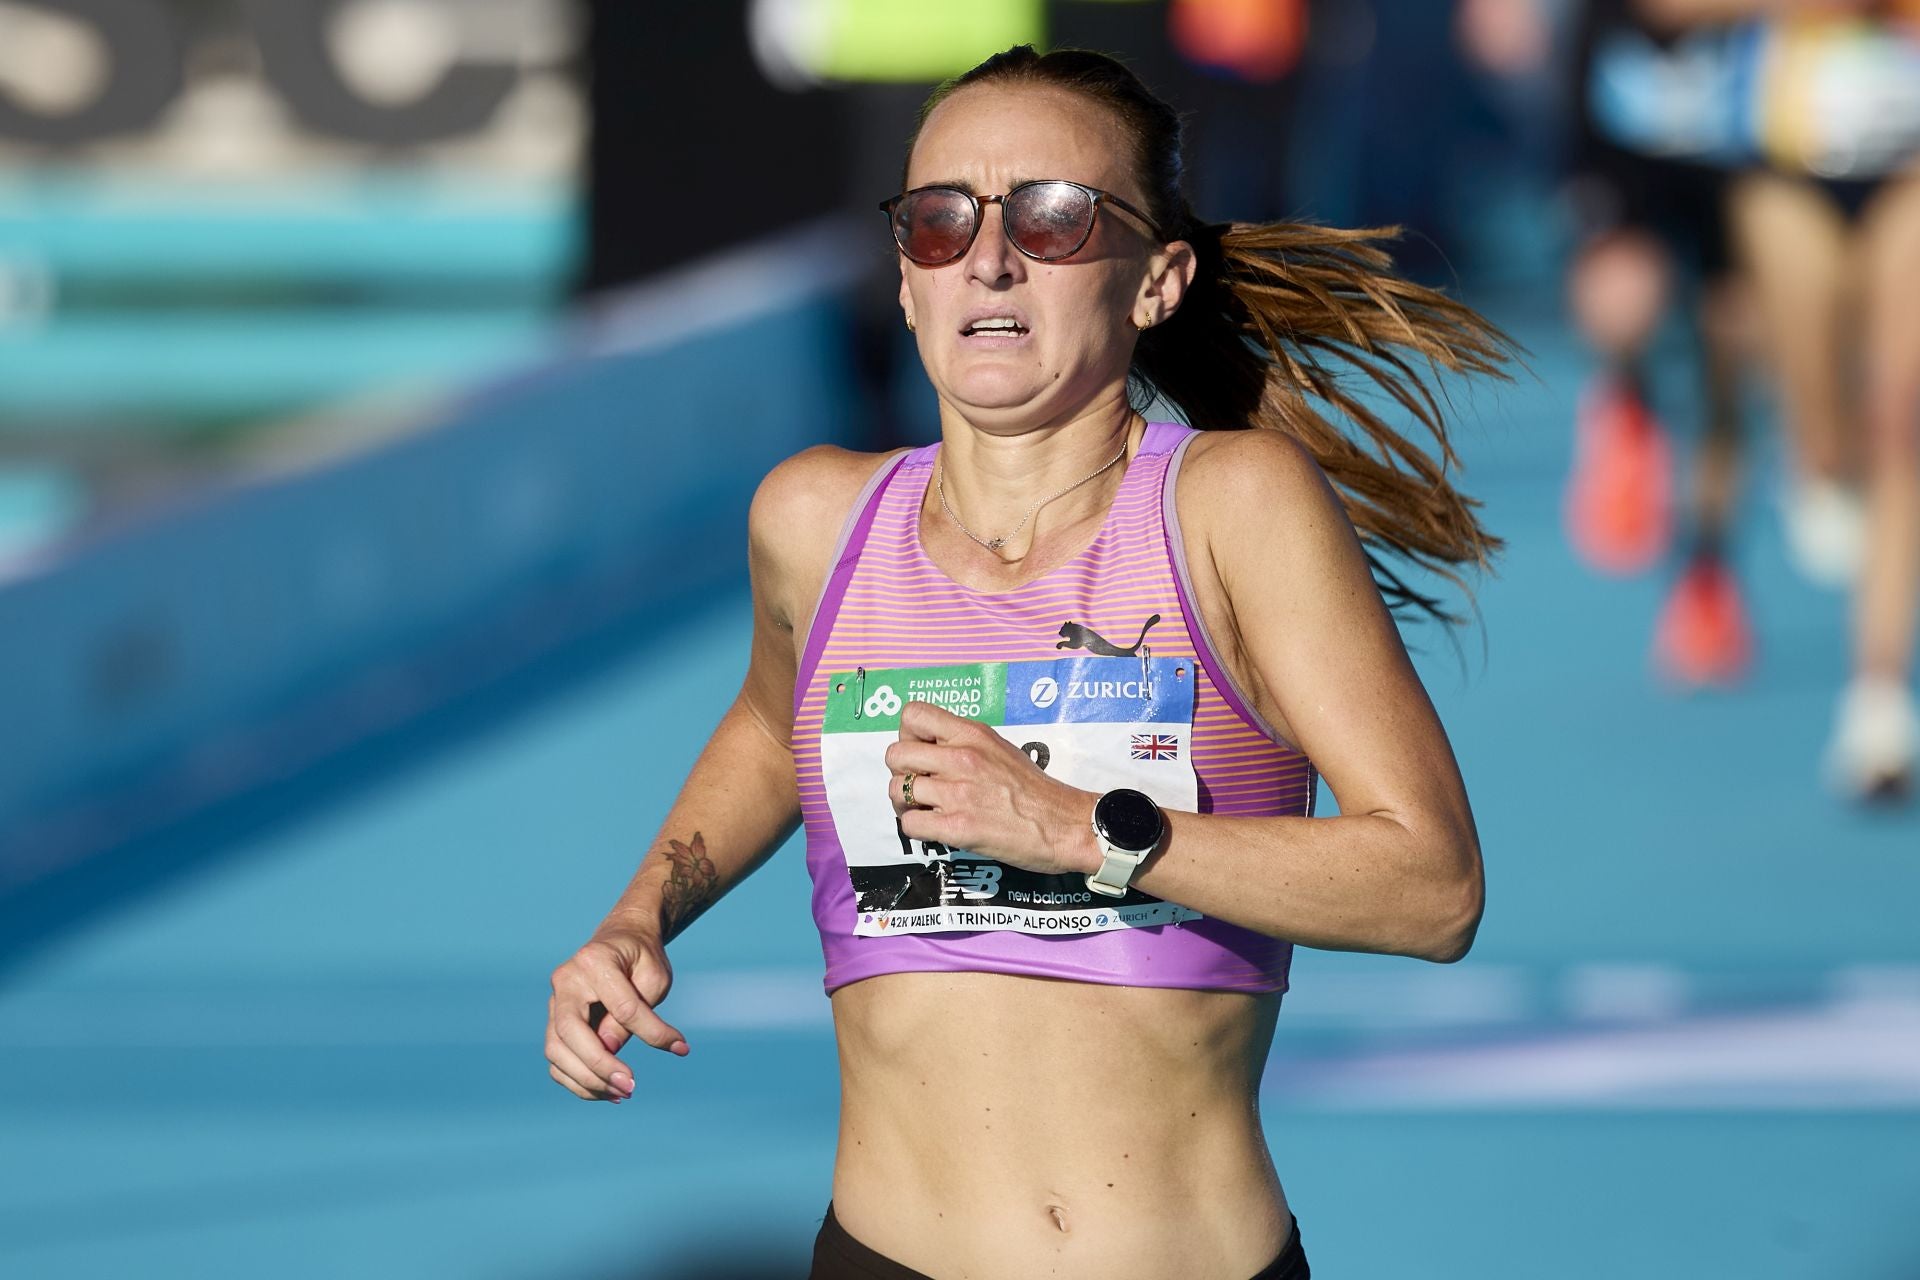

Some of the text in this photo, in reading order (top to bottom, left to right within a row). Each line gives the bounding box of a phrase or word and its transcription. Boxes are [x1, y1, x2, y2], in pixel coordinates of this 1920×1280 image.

[909, 676, 981, 689] FUNDACIÓN
[1067, 681, 1153, 699] ZURICH
[907, 689, 981, 704] TRINIDAD
[1008, 890, 1092, 905] new balance
[890, 916, 908, 928] 42K
[910, 913, 954, 927] VALENCA
[1024, 914, 1092, 929] ALFONSO
[1112, 912, 1148, 923] ZURICH
